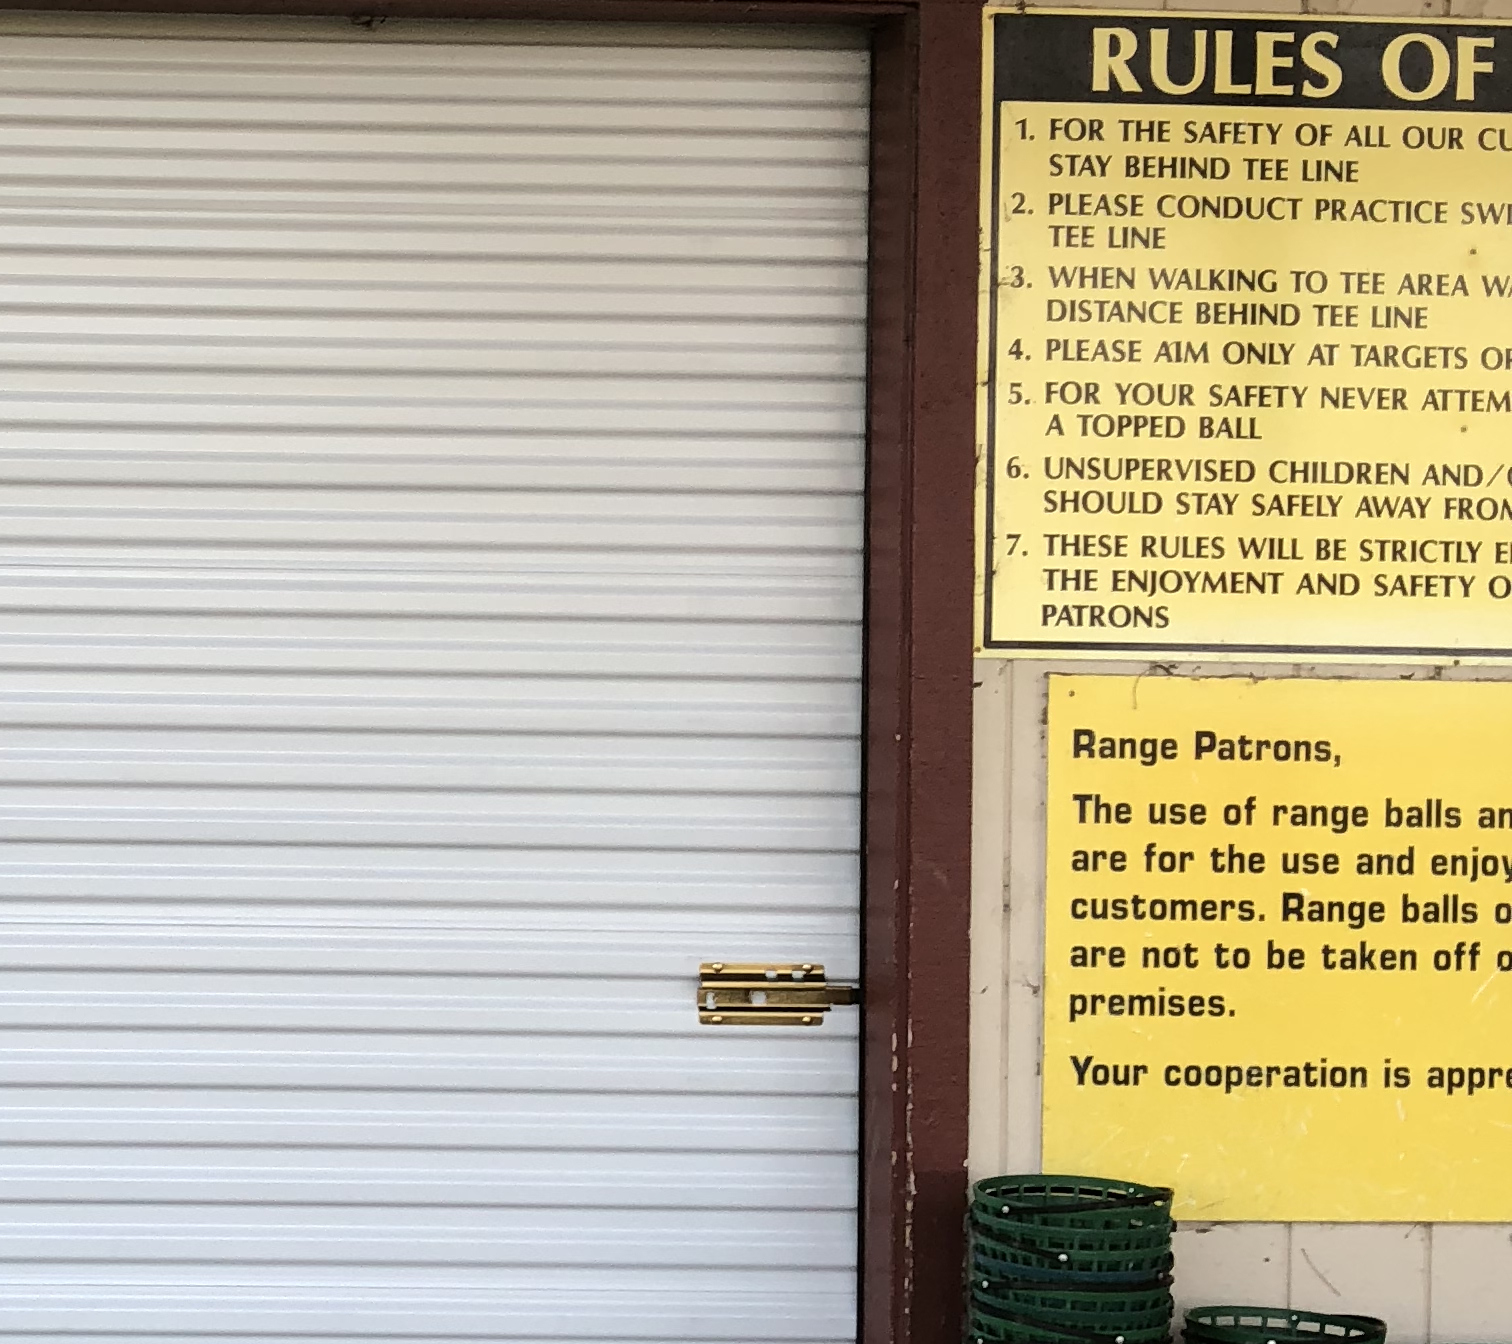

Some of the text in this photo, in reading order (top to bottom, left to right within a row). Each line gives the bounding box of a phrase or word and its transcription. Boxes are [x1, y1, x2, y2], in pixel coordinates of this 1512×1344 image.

[1092, 27, 1494, 101] RULES OF
[1016, 118, 1034, 140] 1.
[1050, 118, 1104, 141] FOR
[1118, 120, 1170, 142] THE
[1184, 121, 1282, 145] SAFETY
[1295, 123, 1332, 146] OF
[1344, 125, 1390, 147] ALL
[1403, 126, 1464, 149] OUR
[1050, 154, 1358, 182] STAY BEHIND TEE LINE
[1011, 192, 1033, 214] 2.
[1049, 193, 1143, 216] PLEASE
[1157, 195, 1302, 220] CONDUCT
[1315, 199, 1447, 223] PRACTICE
[1048, 225, 1165, 249] TEE LINE
[1010, 266, 1032, 288] 3.
[1049, 266, 1135, 289] WHEN
[1149, 268, 1277, 292] WALKING
[1290, 271, 1327, 293] TO
[1340, 272, 1385, 294] TEE
[1398, 274, 1469, 296] AREA
[1047, 299, 1427, 328] DISTANCE BEHIND TEE LINE
[1008, 339, 1030, 360] 4.
[1046, 339, 1141, 362] PLEASE
[1154, 341, 1209, 363] AIM
[1223, 341, 1295, 365] ONLY
[1307, 344, 1339, 365] AT
[1351, 344, 1467, 369] TARGETS
[1008, 381, 1511, 412] 5. FOR YOUR SAFETY NEVER ATTEM
[1045, 414, 1262, 439] A TOPPED BALL
[1007, 456, 1512, 487] 6. UNSUPERVISED CHILDREN AND/
[1044, 490, 1162, 514] SHOULD
[1177, 492, 1239, 515] STAY
[1252, 494, 1343, 517] SAFELY
[1355, 496, 1431, 518] AWAY
[1007, 534, 1027, 556] 7.
[1043, 534, 1127, 557] THESE
[1141, 536, 1224, 559] RULES
[1238, 537, 1303, 560] WILL
[1316, 539, 1346, 560] BE
[1360, 539, 1482, 563] STRICTLY
[1043, 569, 1098, 591] THE
[1113, 570, 1284, 597] ENJOYMENT
[1296, 573, 1360, 595] AND
[1375, 574, 1475, 597] SAFETY
[1042, 605, 1169, 628] PATRONS
[1074, 729, 1340, 767] Range Patrons,
[1073, 794, 1131, 824] The
[1149, 804, 1206, 825] use
[1224, 796, 1256, 825] of
[1273, 805, 1368, 833] range
[1385, 798, 1461, 828] balls
[1072, 850, 1126, 872] are
[1144, 843, 1194, 872] for
[1211, 844, 1265, 873] the
[1283, 853, 1339, 874] use
[1357, 846, 1414, 875] and
[1071, 895, 1264, 921] customers.
[1283, 892, 1384, 929] Range
[1402, 894, 1477, 923] balls
[1071, 946, 1125, 967] are
[1143, 943, 1198, 968] not
[1215, 943, 1250, 969] to
[1267, 940, 1304, 969] be
[1322, 941, 1416, 970] taken
[1434, 942, 1480, 971] off
[1070, 987, 1235, 1022] premises.
[1070, 1056, 1148, 1086] Your
[1165, 1058, 1367, 1093] cooperation
[1385, 1059, 1410, 1088] is
